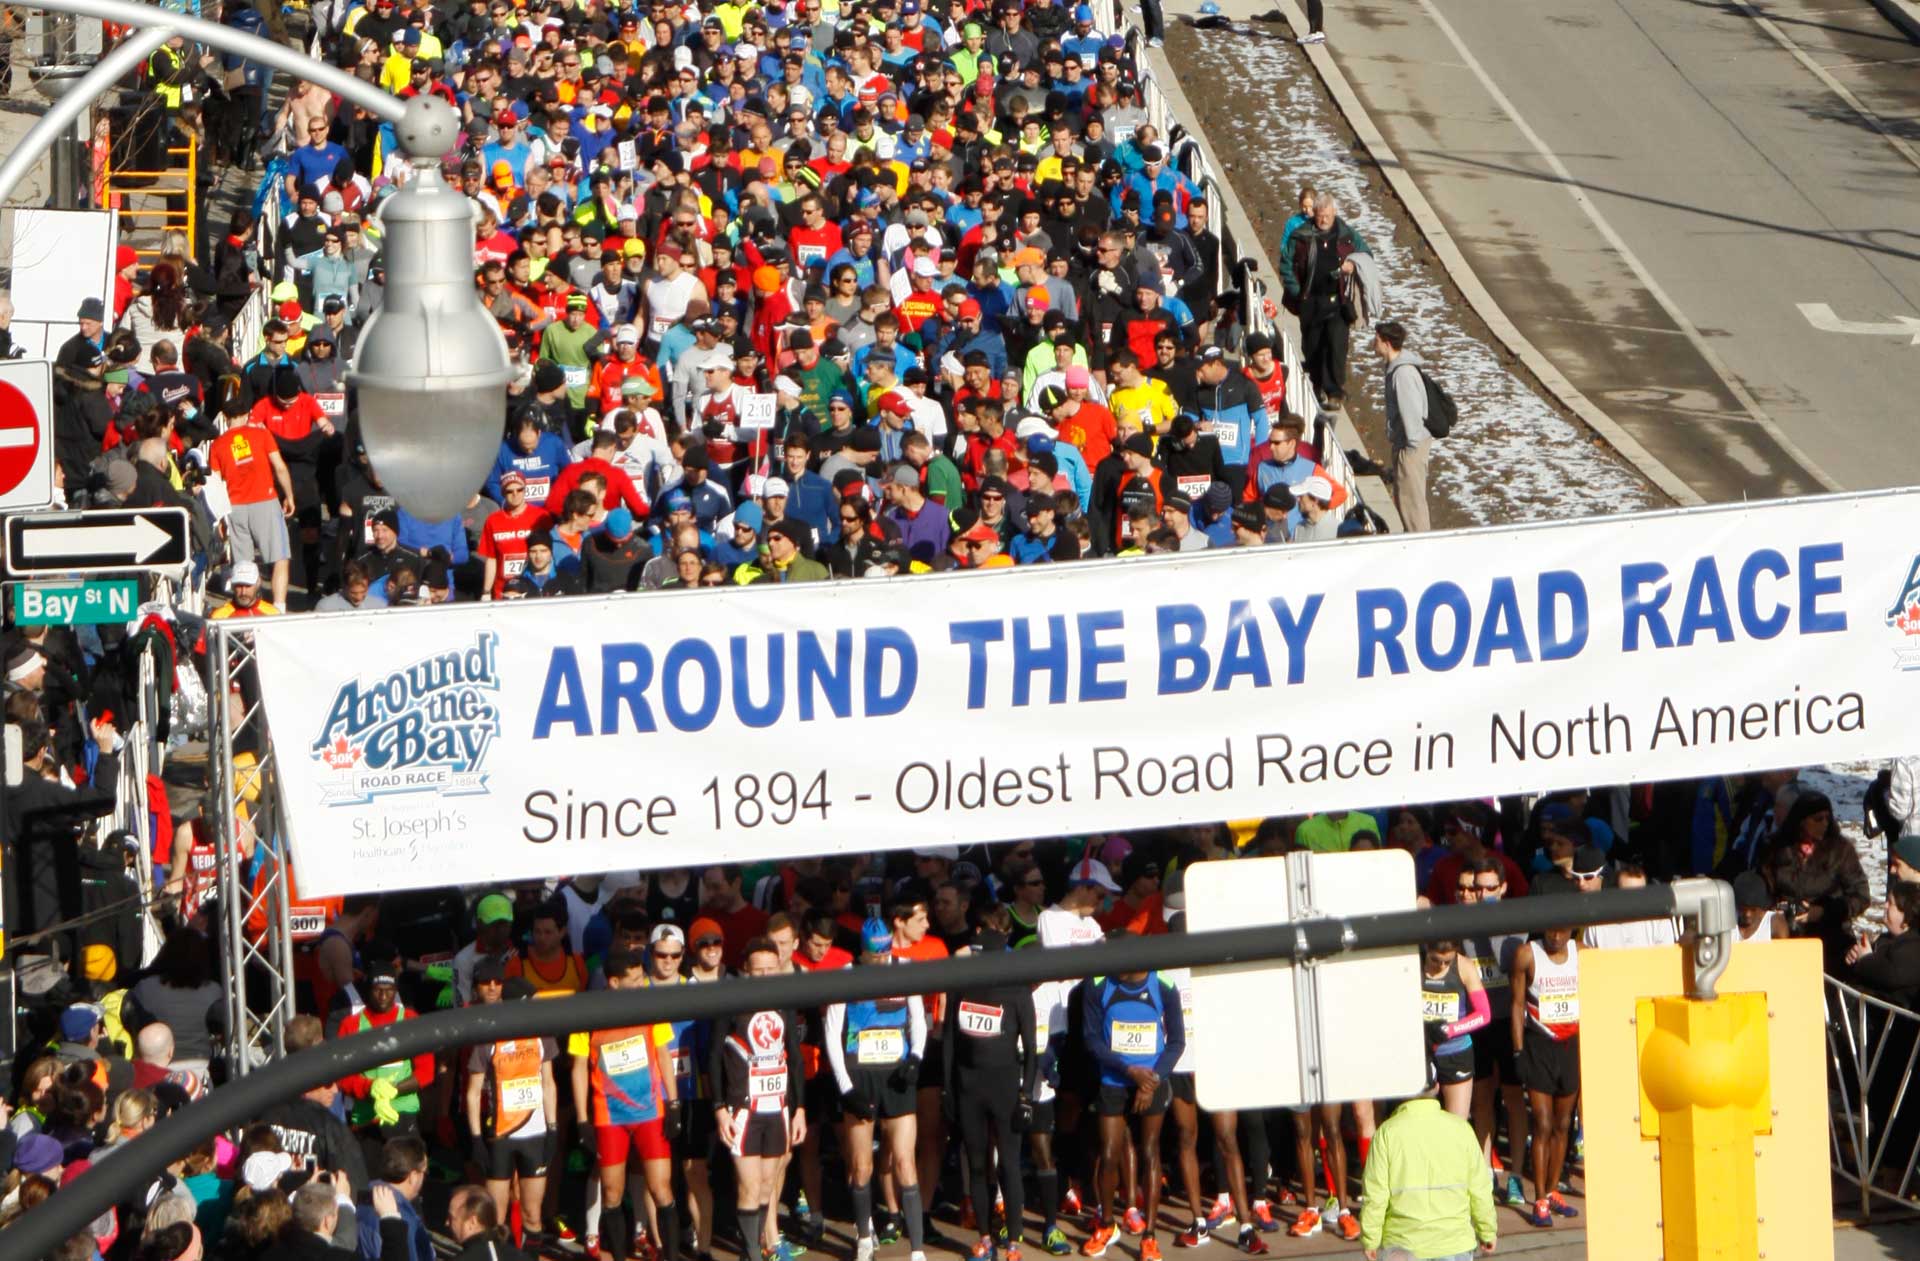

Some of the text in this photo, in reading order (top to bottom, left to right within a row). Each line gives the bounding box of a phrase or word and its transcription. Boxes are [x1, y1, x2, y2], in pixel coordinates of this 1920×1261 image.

[747, 403, 771, 417] 2:10
[23, 587, 130, 624] Bay St N
[532, 542, 1848, 740] AROUND THE BAY ROAD RACE
[312, 632, 491, 752] Around
[425, 687, 493, 724] the
[363, 709, 494, 773] Bay
[329, 752, 354, 765] 30K
[522, 790, 676, 844] Since
[703, 769, 832, 831] 1894
[894, 752, 1073, 814] Oldest
[1093, 737, 1234, 801] Road
[1256, 733, 1393, 787] Race
[1413, 722, 1455, 772] in
[1490, 702, 1633, 765] North
[1649, 685, 1866, 751] America
[360, 770, 447, 789] ROAD RACE
[353, 809, 467, 841] St. Joseph's
[1425, 1002, 1447, 1015] 21F
[1554, 1001, 1569, 1013] 39
[967, 1015, 993, 1031] 170
[874, 1039, 889, 1051] 18
[1127, 1031, 1142, 1044] 20
[621, 1051, 630, 1062] 5
[758, 1076, 782, 1092] 166
